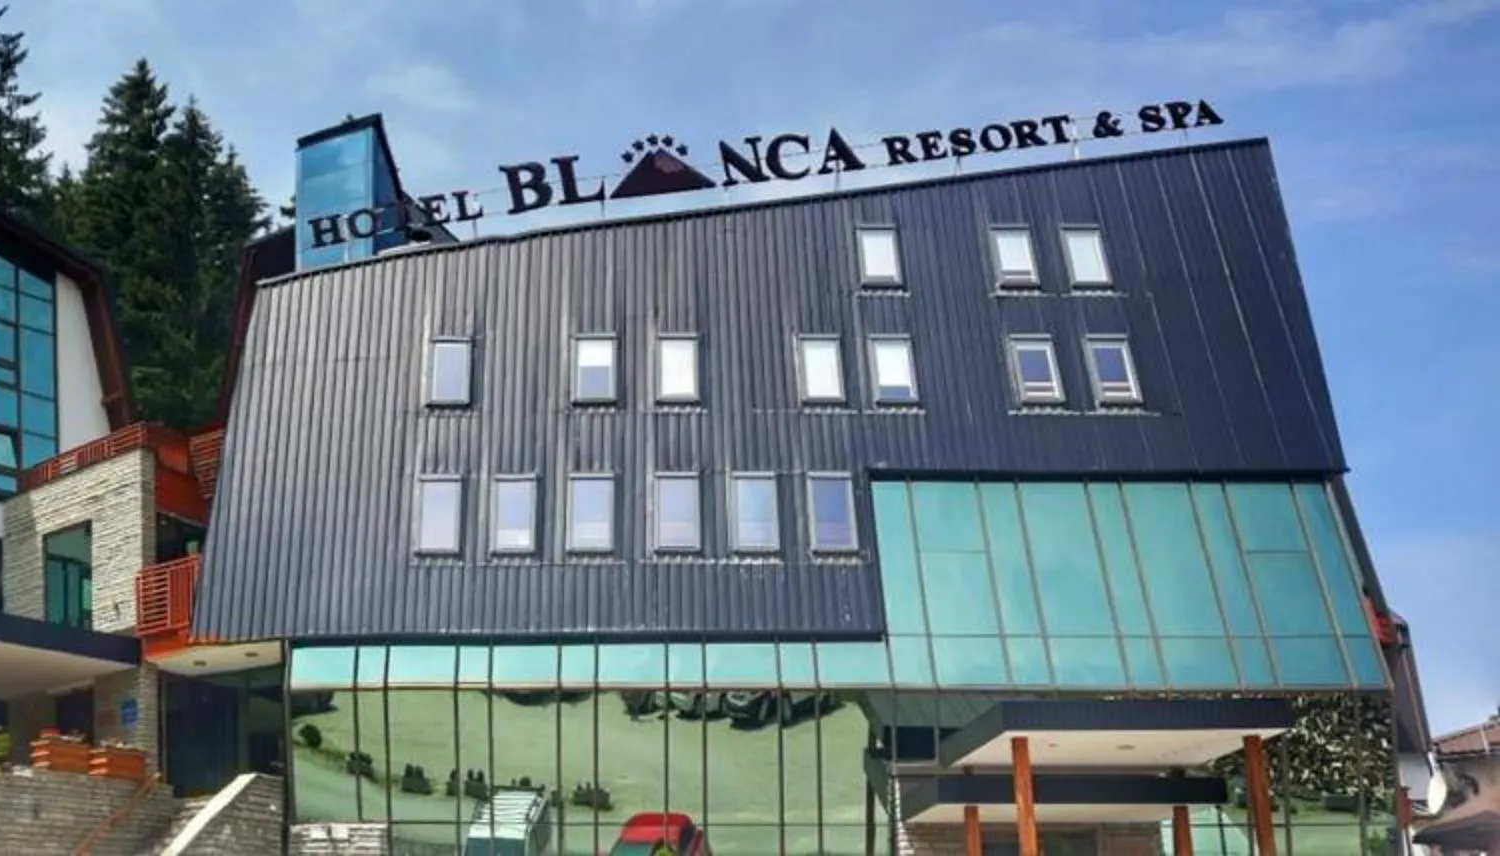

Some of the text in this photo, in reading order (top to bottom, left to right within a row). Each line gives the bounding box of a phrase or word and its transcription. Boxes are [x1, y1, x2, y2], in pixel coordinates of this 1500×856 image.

[882, 114, 1071, 166] RESORT
[1092, 110, 1125, 139] &
[1137, 99, 1225, 133] SPA
